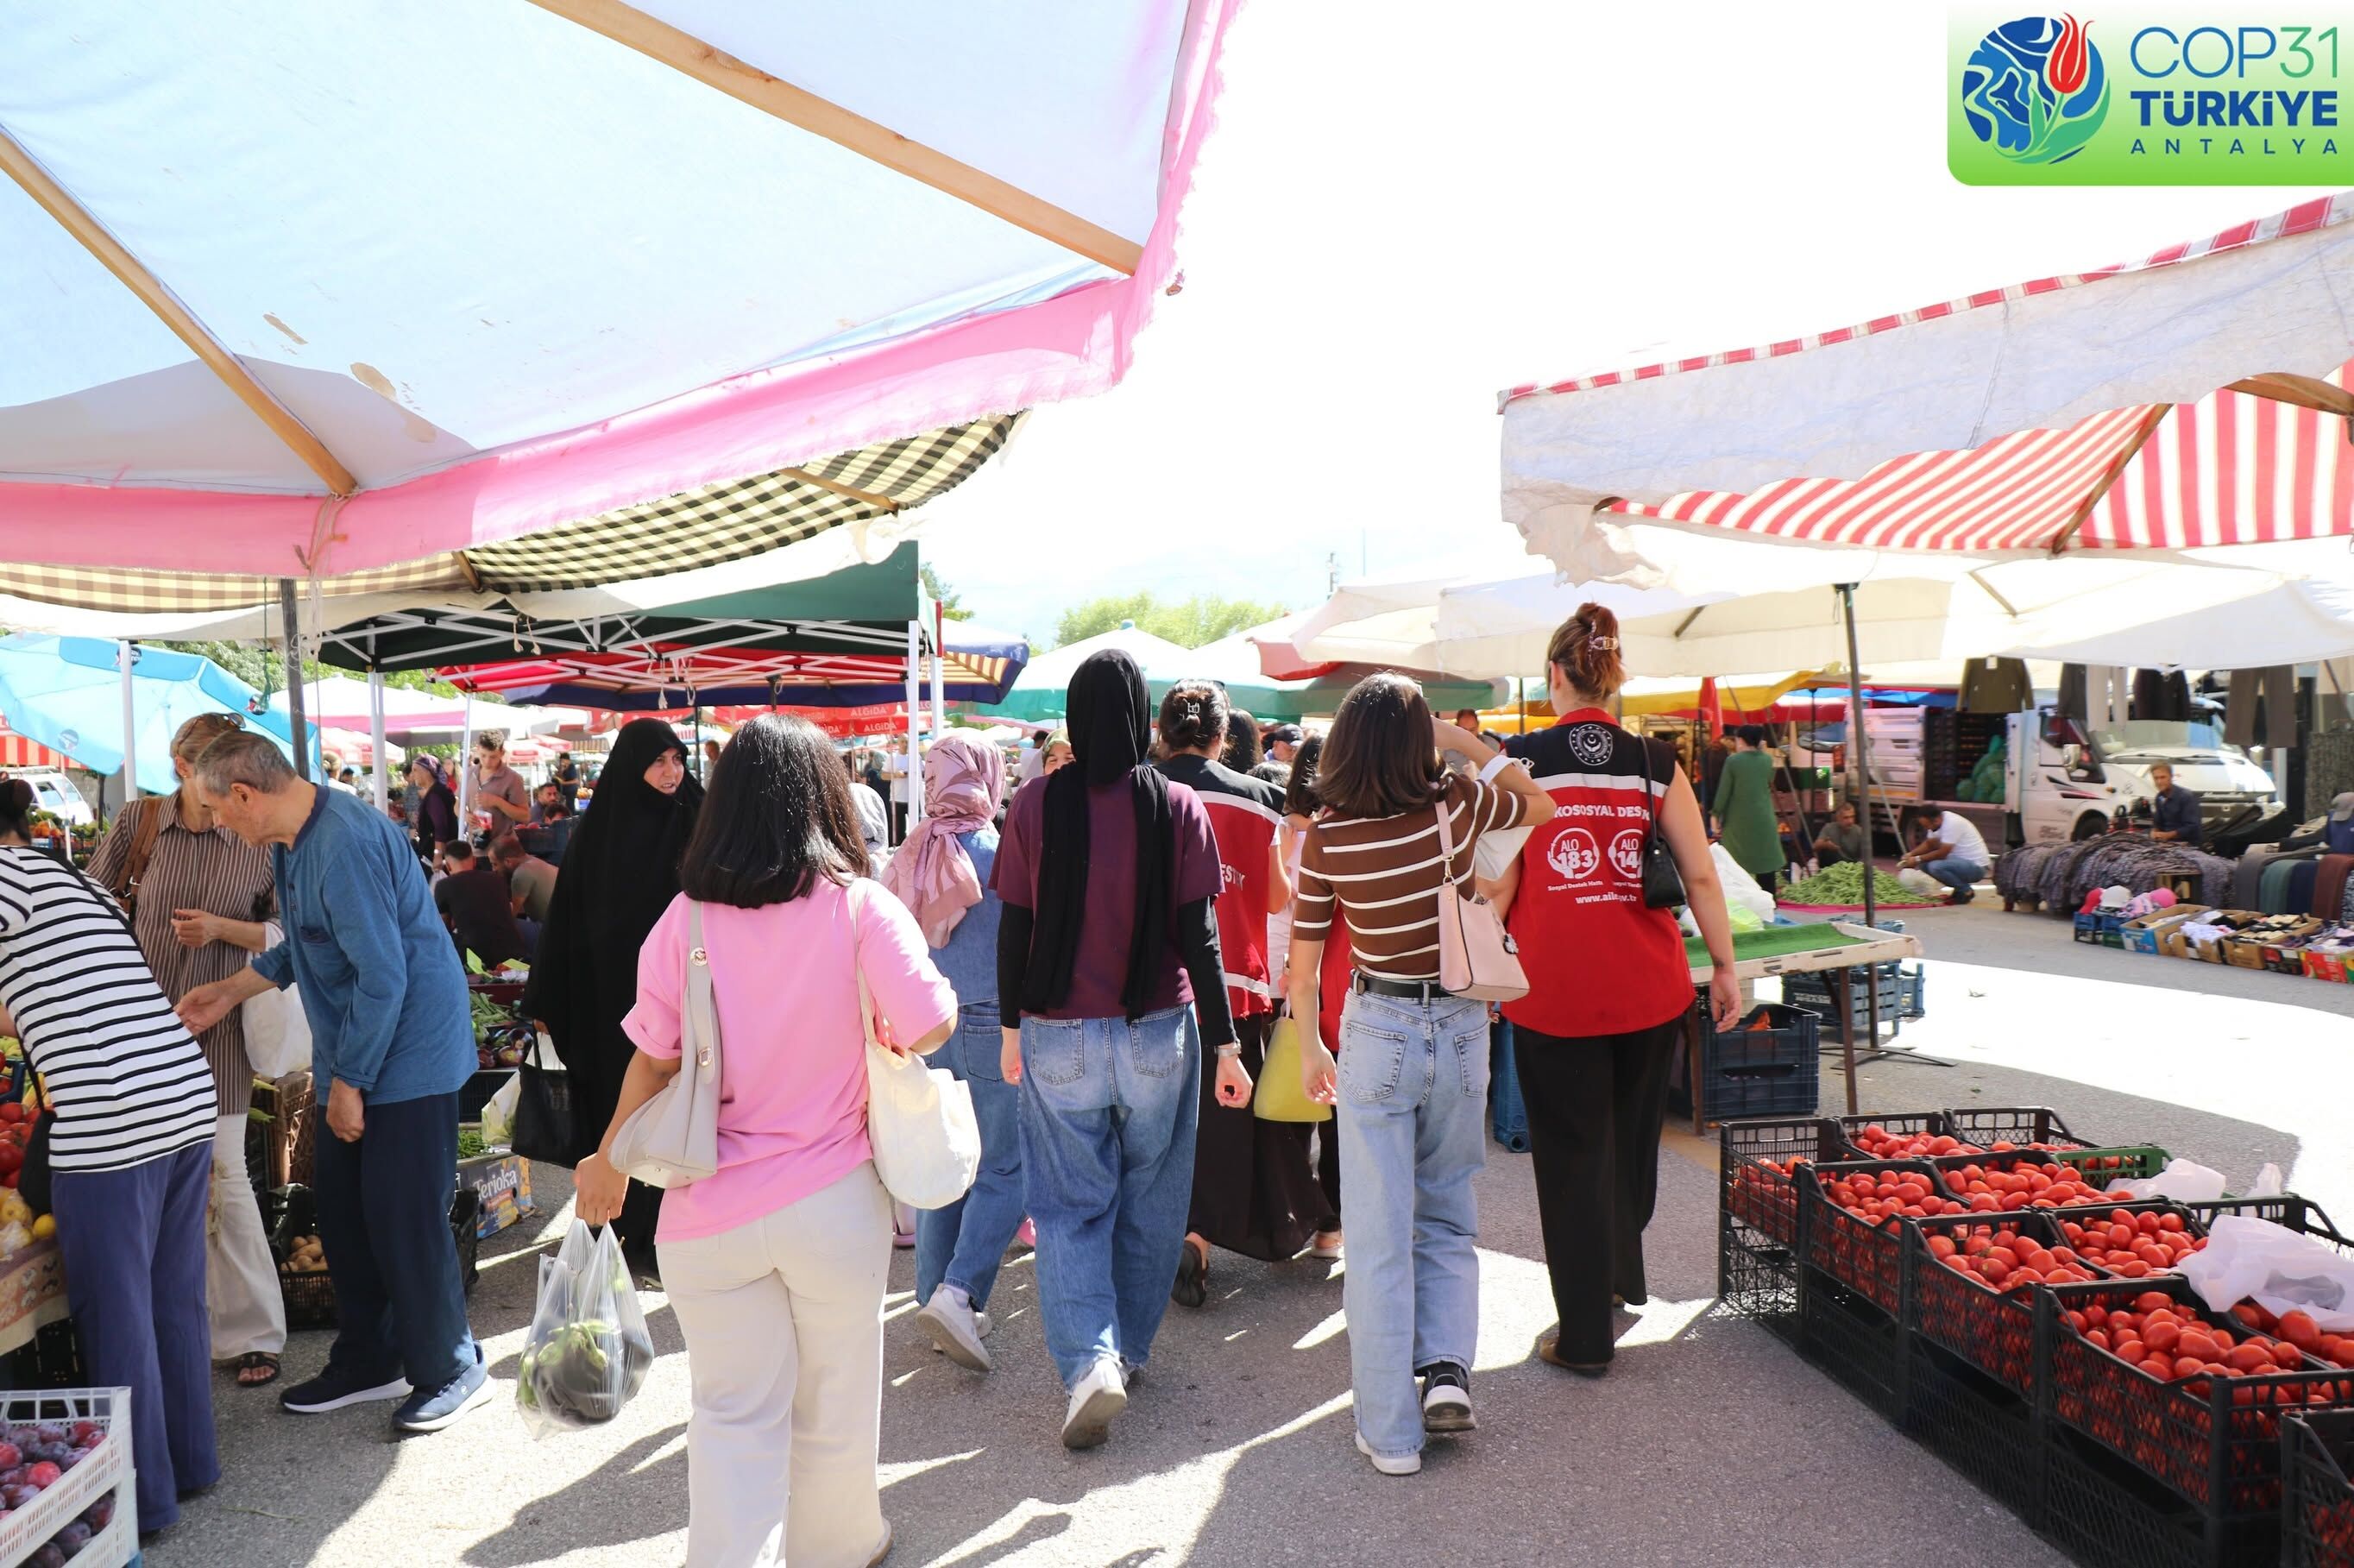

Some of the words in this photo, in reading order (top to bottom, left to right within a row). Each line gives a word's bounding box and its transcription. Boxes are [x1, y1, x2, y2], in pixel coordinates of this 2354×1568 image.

[1561, 838, 1580, 853] ALO
[1621, 838, 1639, 851] ALO
[1557, 850, 1593, 869] 183
